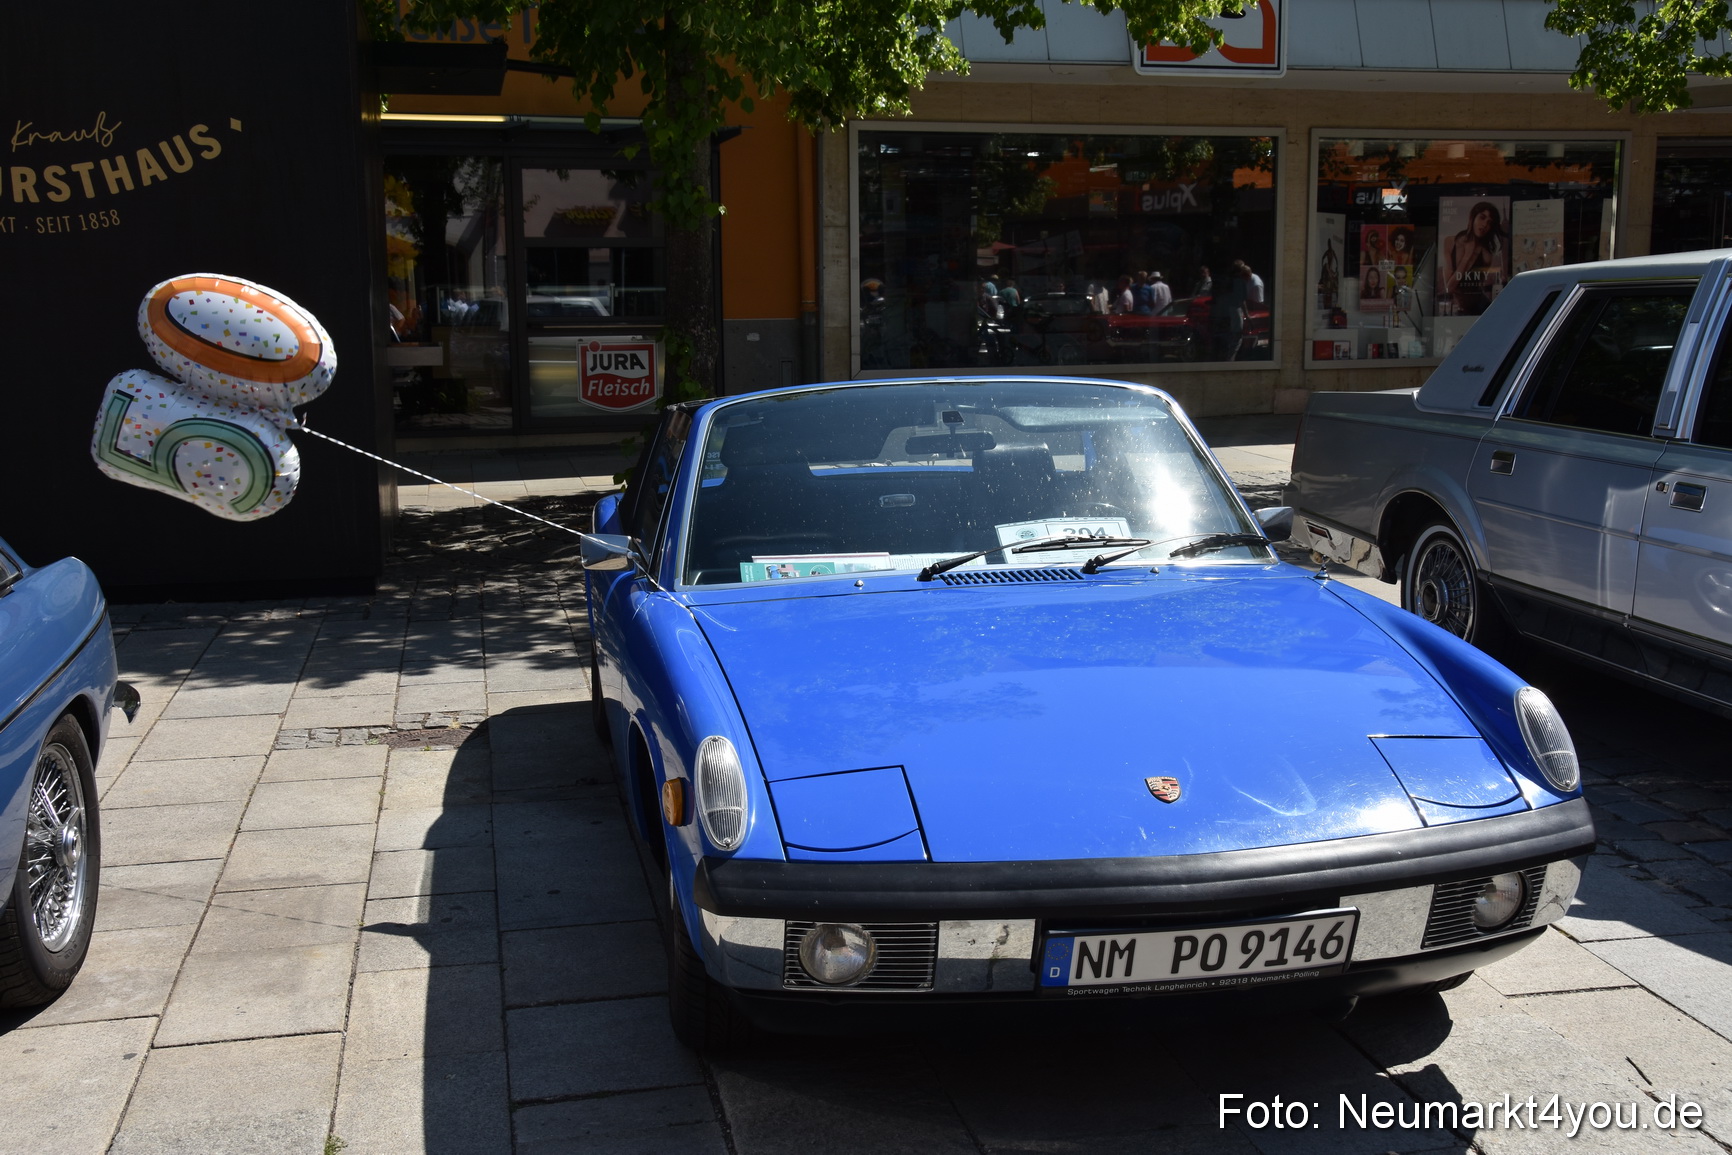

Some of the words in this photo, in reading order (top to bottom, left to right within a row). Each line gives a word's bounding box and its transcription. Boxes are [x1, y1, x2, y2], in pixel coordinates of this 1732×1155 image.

[37, 214, 72, 234] SEIT
[78, 209, 121, 232] 1858
[1455, 270, 1490, 281] DKNY
[587, 378, 650, 397] Fleisch
[1075, 938, 1137, 980] NM
[1170, 933, 1228, 974] PO
[1238, 920, 1345, 969] 9146
[1049, 966, 1061, 978] D
[1067, 986, 1119, 996] Sportwagen
[1122, 985, 1152, 993] Technik
[1154, 981, 1208, 991] Langheinrich
[1219, 977, 1248, 986] 92318
